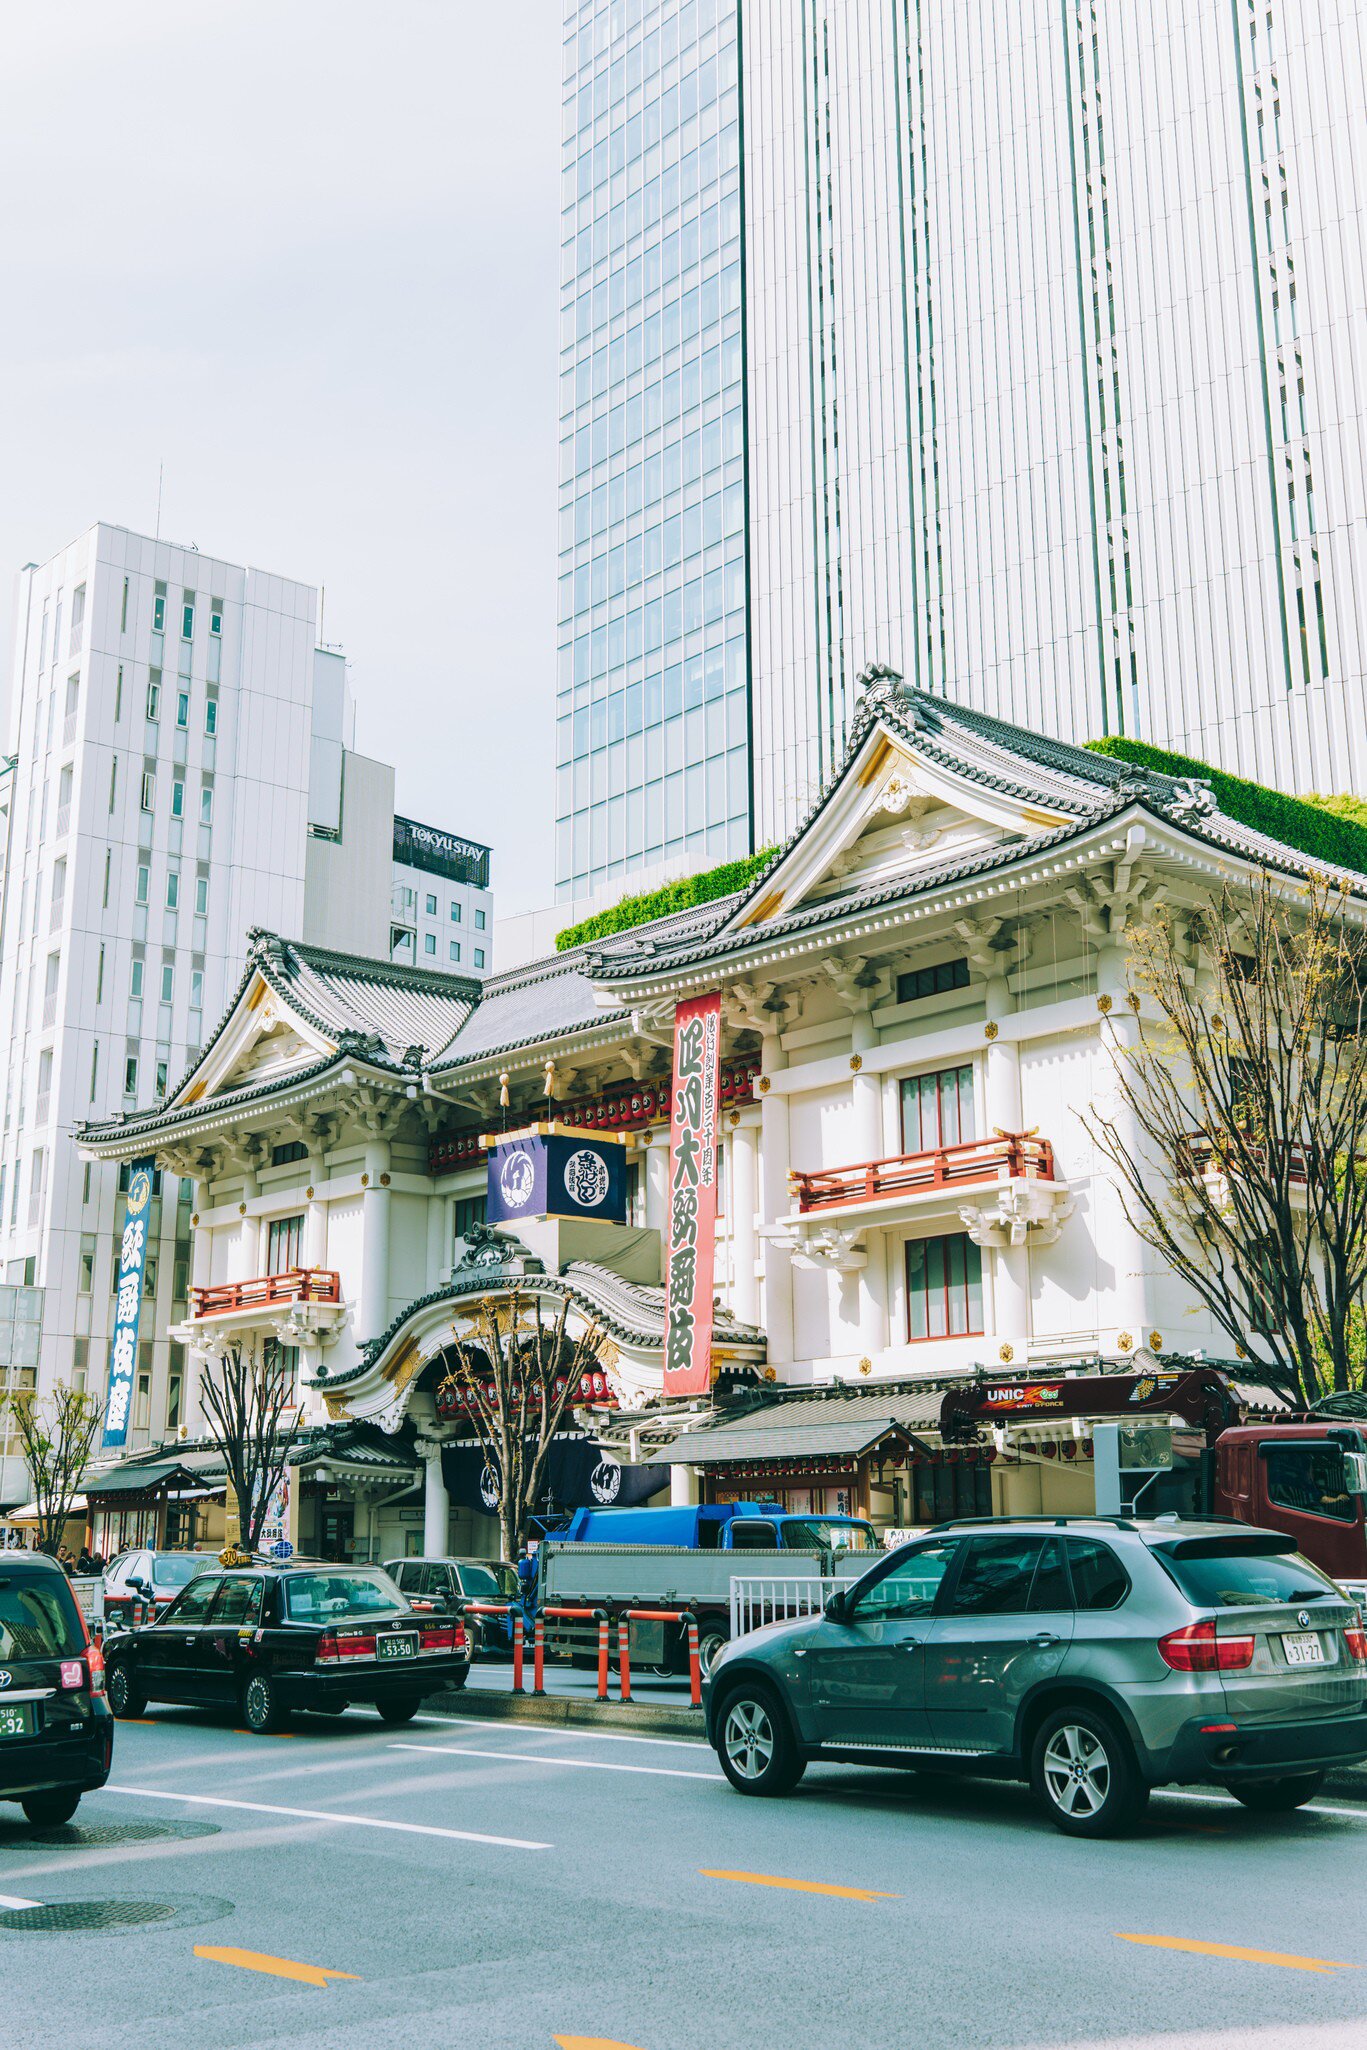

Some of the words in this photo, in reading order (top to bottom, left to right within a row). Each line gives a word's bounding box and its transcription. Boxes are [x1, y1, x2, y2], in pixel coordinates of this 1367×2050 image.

[409, 826, 452, 850] TOKYU
[453, 841, 484, 862] STAY
[106, 1220, 144, 1431] 歌舞伎座
[987, 1388, 1024, 1401] UNIC
[223, 1549, 236, 1561] 370
[387, 1644, 411, 1656] 53-50
[1293, 1645, 1320, 1661] 31-27
[0, 1717, 24, 1733] -92
